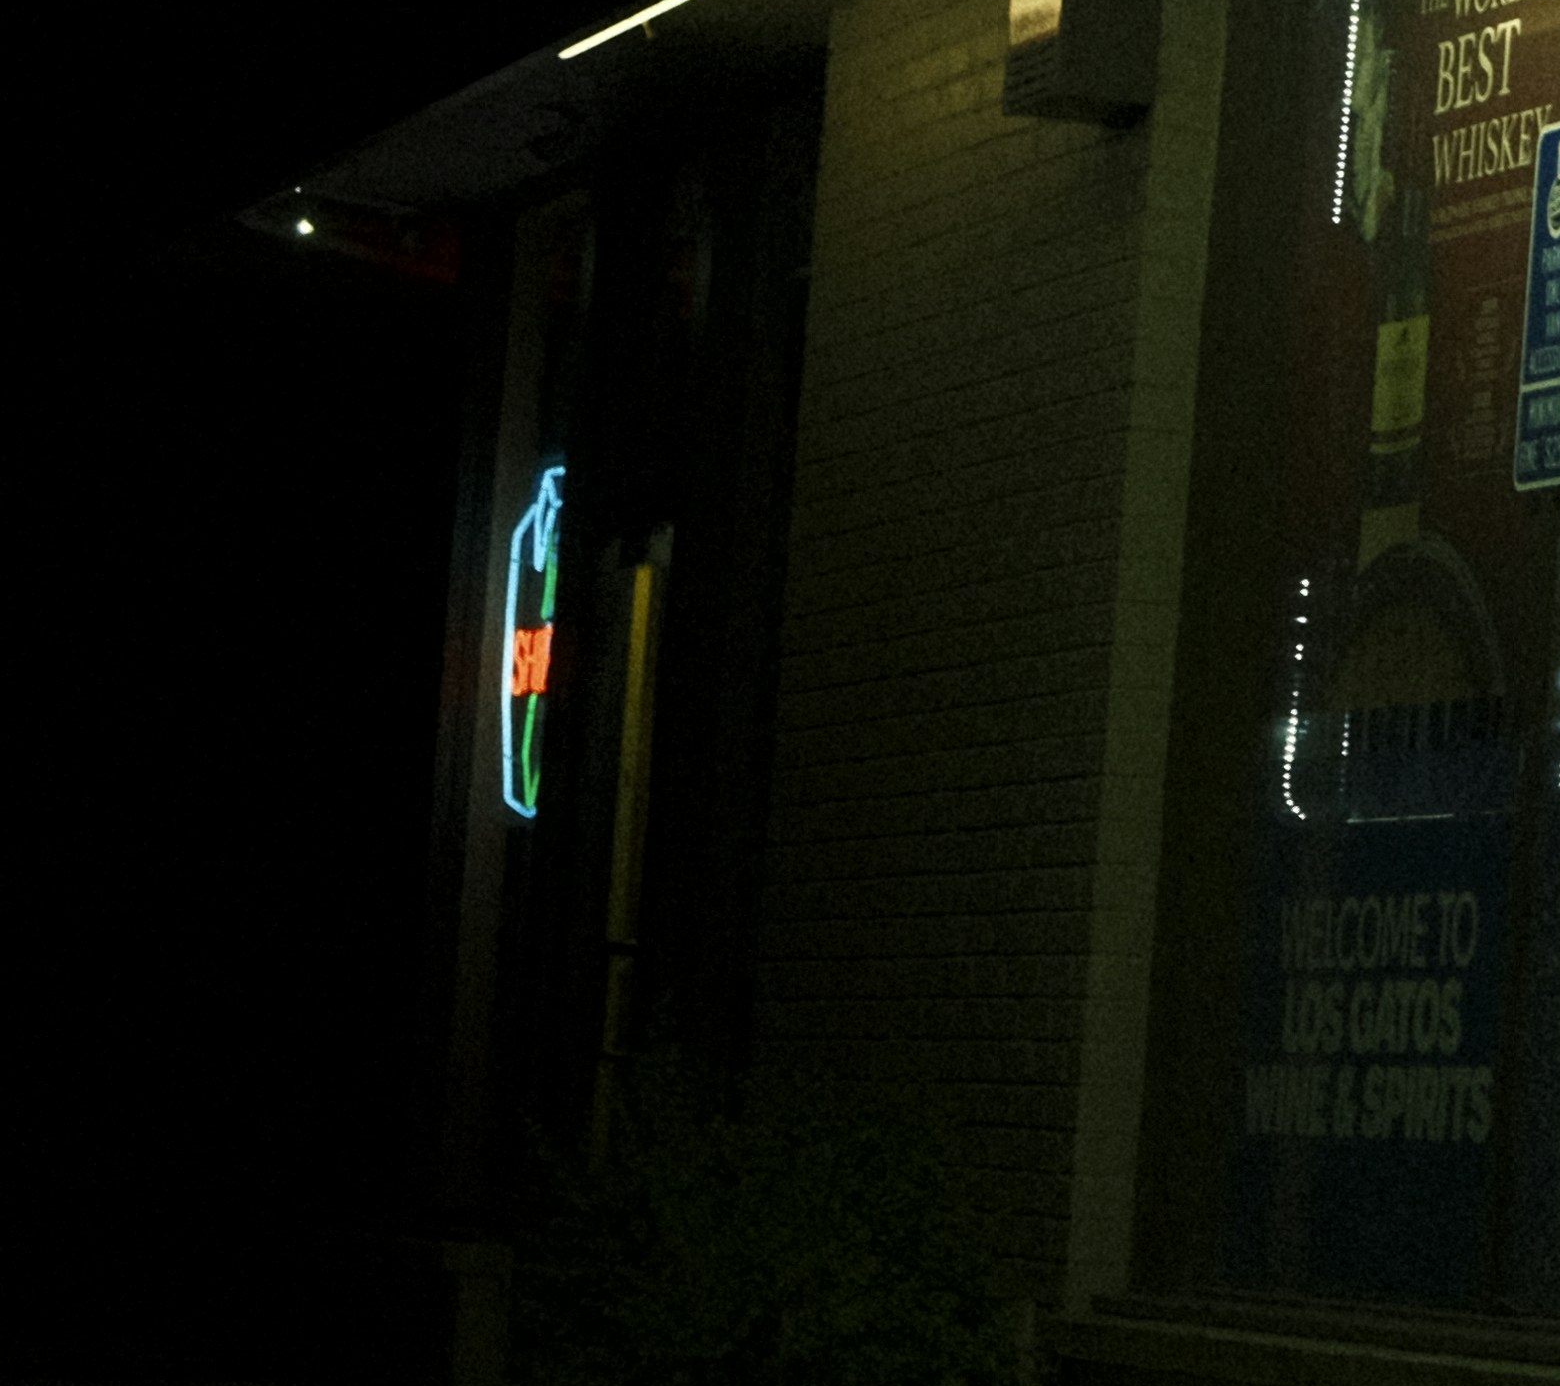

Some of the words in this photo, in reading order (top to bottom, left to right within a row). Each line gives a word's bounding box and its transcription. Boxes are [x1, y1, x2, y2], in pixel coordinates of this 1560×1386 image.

[1434, 17, 1523, 117] BEST
[1431, 102, 1554, 188] WHISKEY
[1438, 889, 1479, 969] TO
[1281, 979, 1345, 1055] LOS
[1350, 975, 1464, 1056] GATOS
[1246, 1063, 1329, 1139] WINE
[1363, 1063, 1495, 1145] SPIRITS
